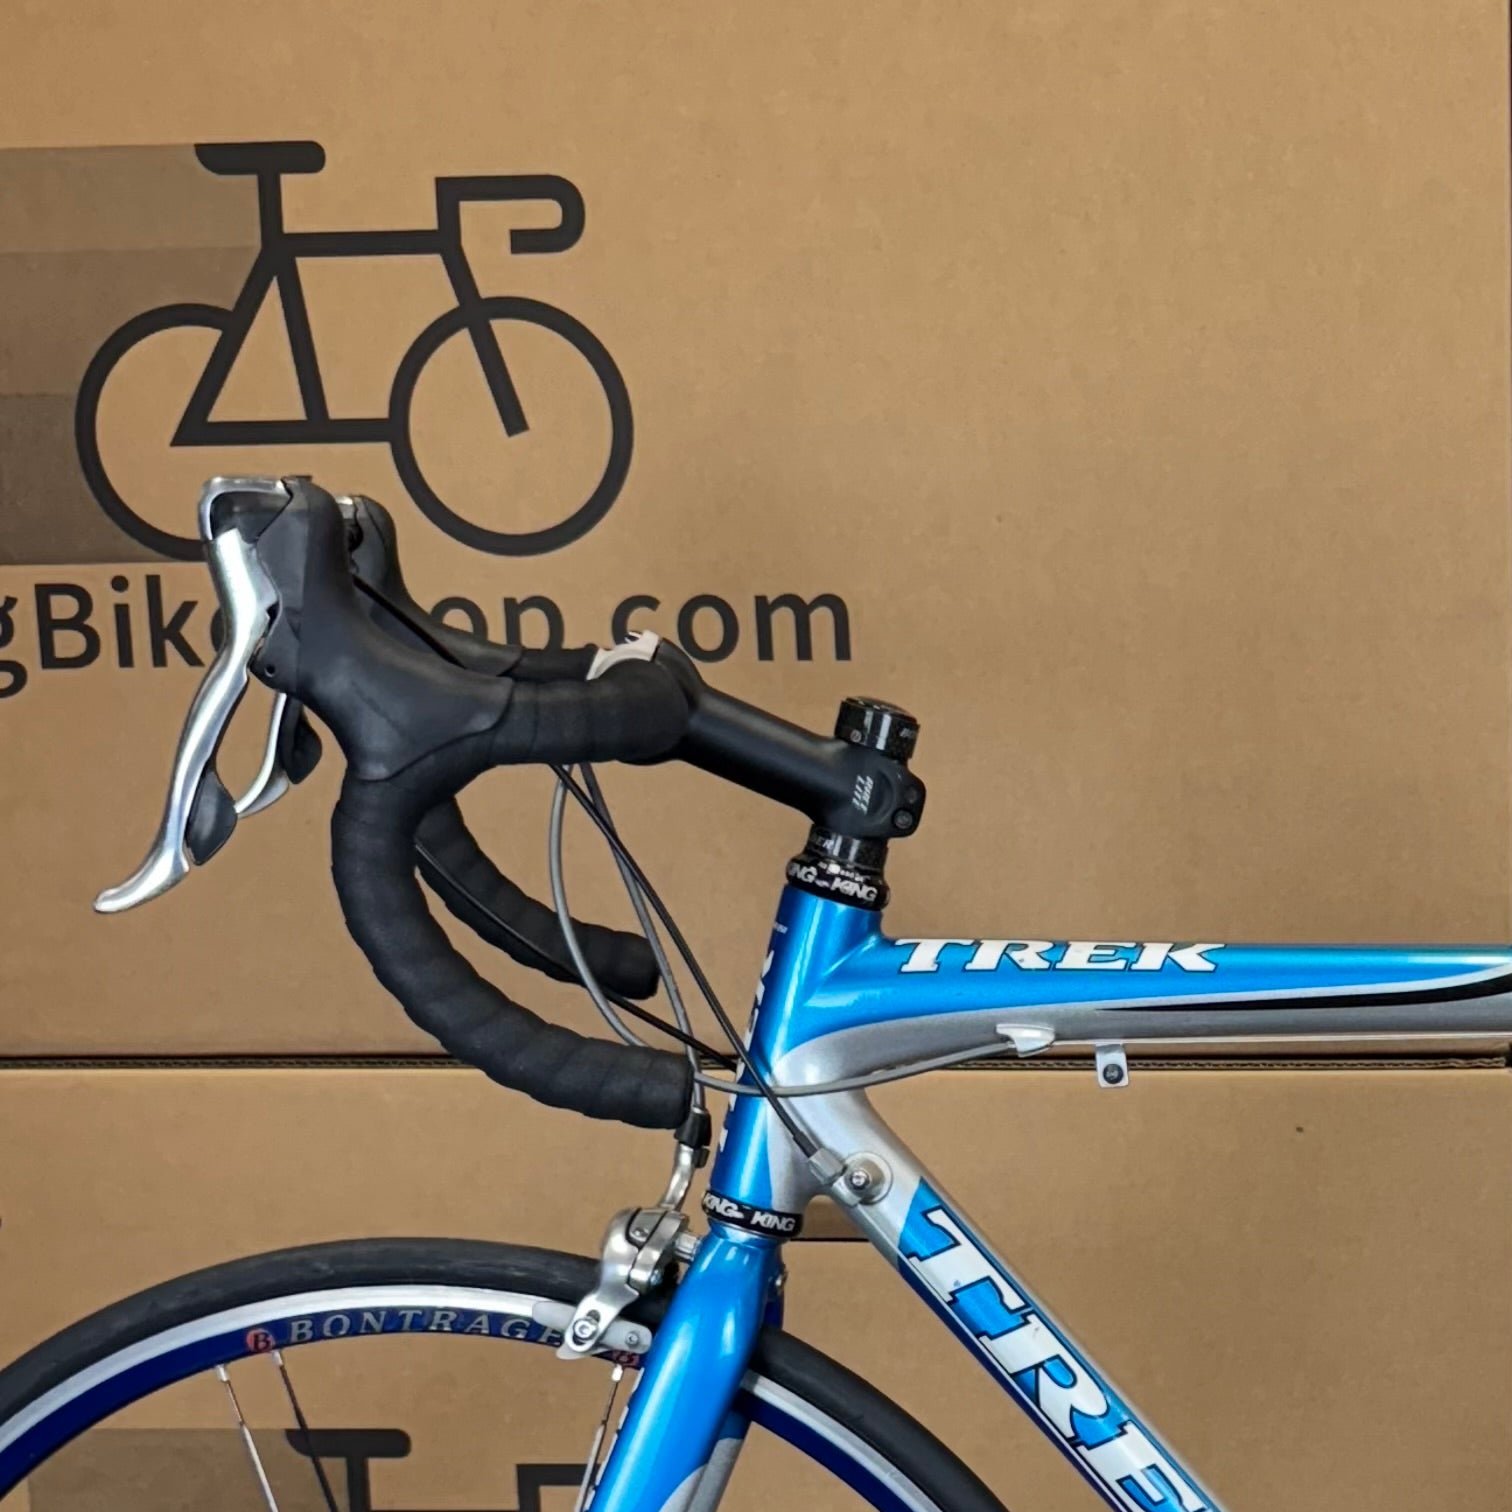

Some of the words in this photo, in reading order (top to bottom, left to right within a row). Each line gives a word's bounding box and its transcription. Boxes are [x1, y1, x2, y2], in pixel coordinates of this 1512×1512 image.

[893, 937, 1226, 973] TREK
[750, 1211, 797, 1233] KING
[289, 1308, 563, 1346] BONTRAGE
